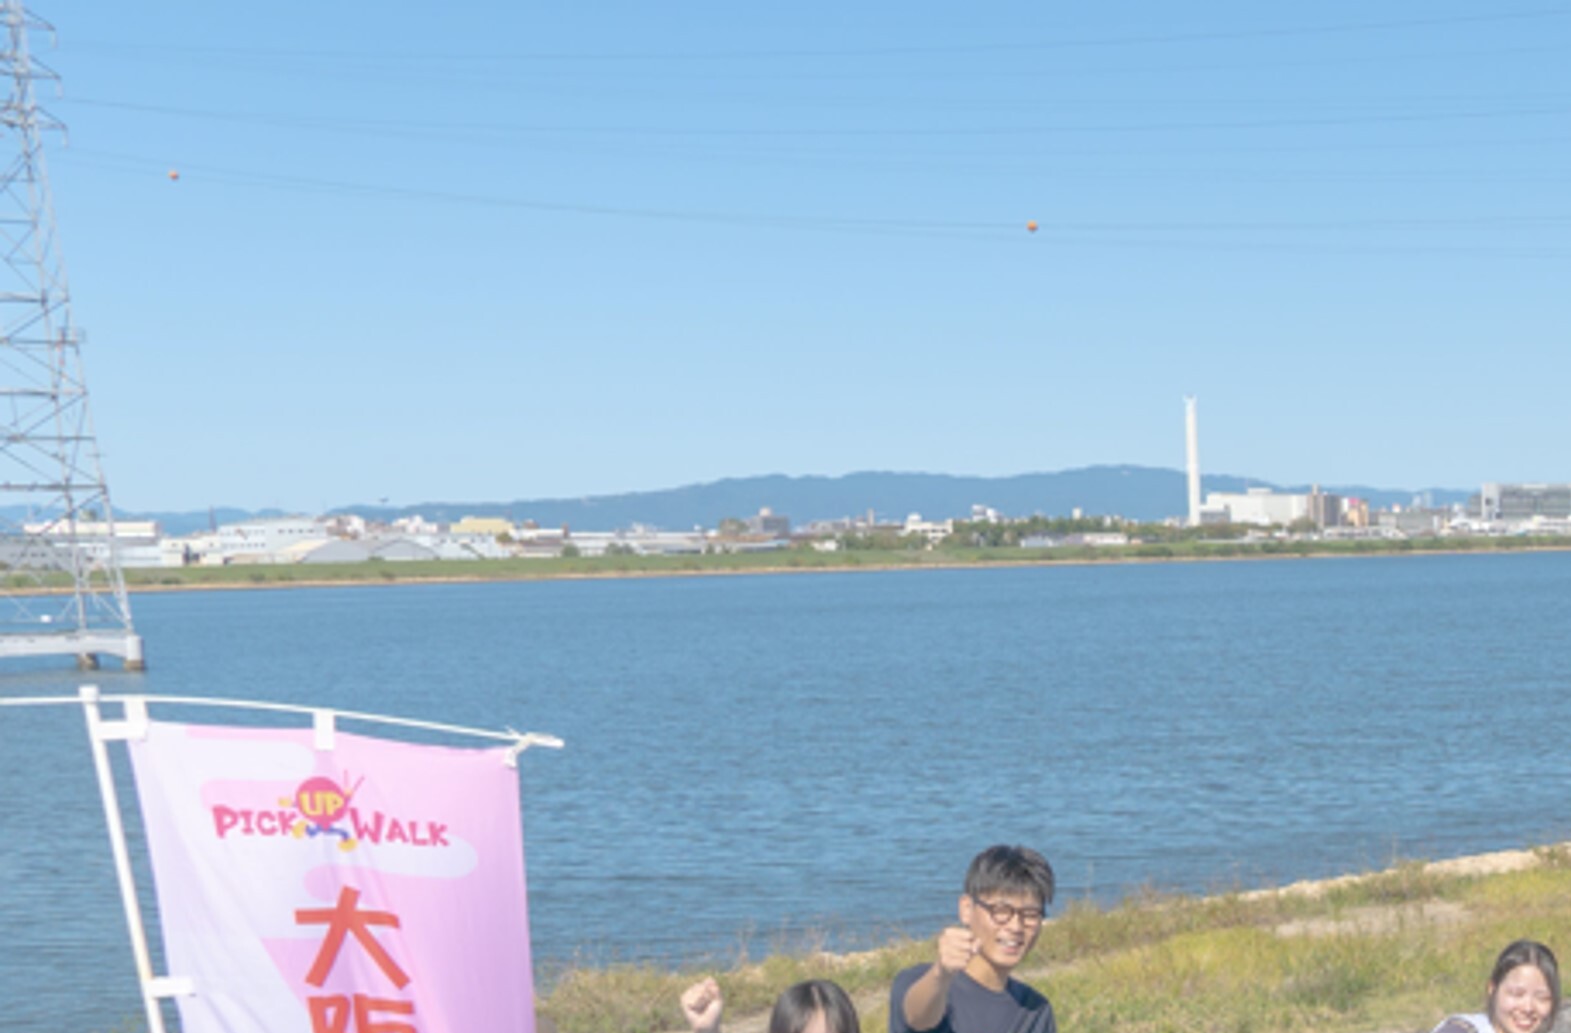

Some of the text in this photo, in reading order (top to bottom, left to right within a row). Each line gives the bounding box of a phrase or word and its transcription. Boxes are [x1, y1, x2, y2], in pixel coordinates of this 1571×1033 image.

[212, 790, 450, 847] PICK UP WALK
